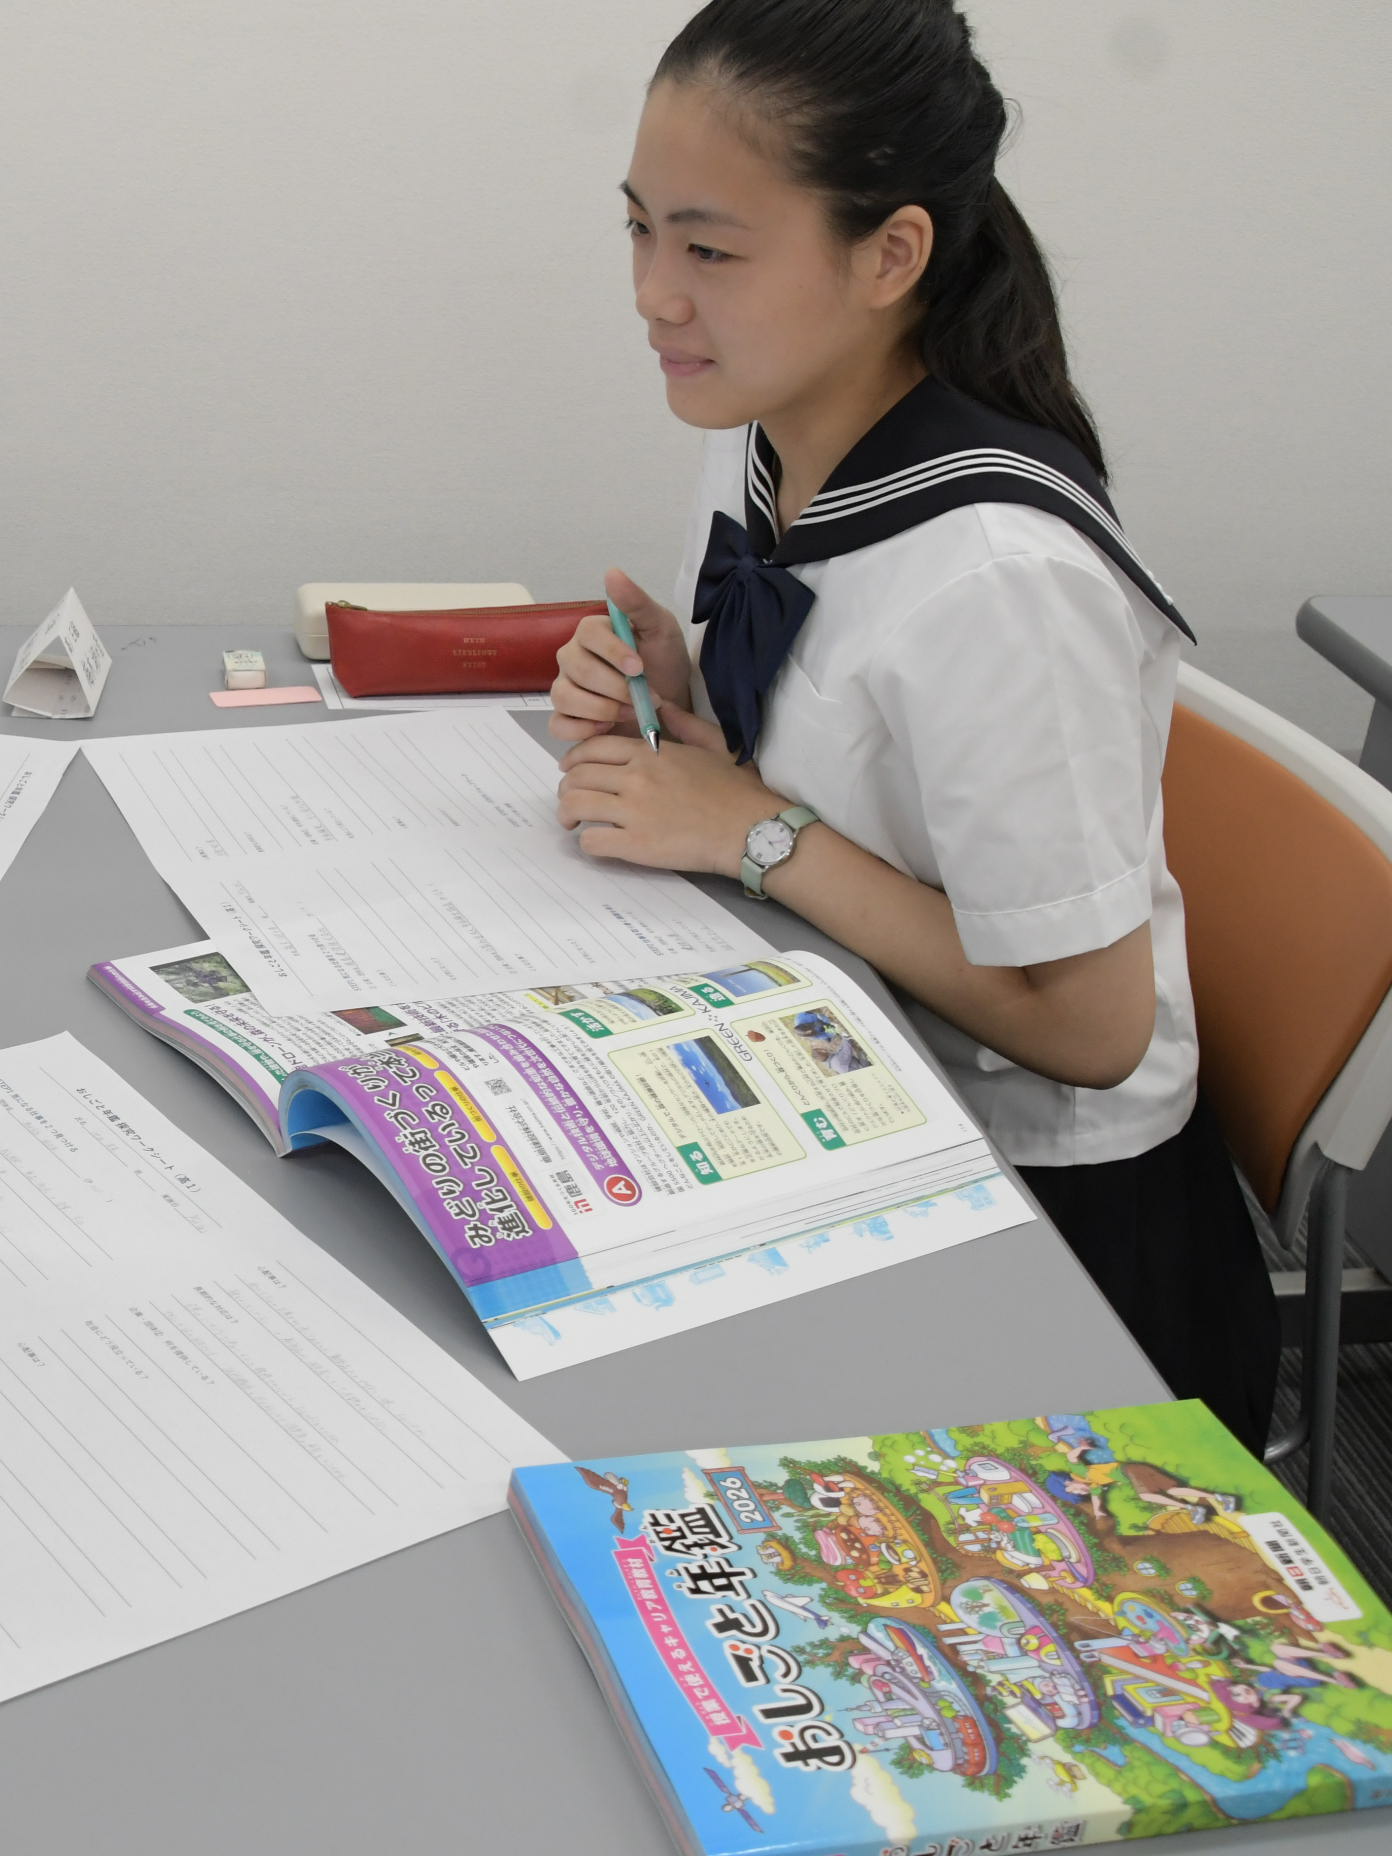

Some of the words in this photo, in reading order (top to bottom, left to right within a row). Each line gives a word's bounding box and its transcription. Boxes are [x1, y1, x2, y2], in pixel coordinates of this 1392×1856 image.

[569, 1010, 604, 1032] 活かす
[714, 1022, 754, 1062] GREEN
[74, 1086, 122, 1123] おしごと年鑑
[344, 1066, 497, 1248] みどりの街づくりが
[687, 1149, 714, 1175] 知る
[607, 1180, 632, 1197] A
[717, 1476, 765, 1524] 2026
[625, 1557, 731, 1726] 授業で使えるキャリア教育教材
[644, 1503, 848, 1773] おしごと年鑑
